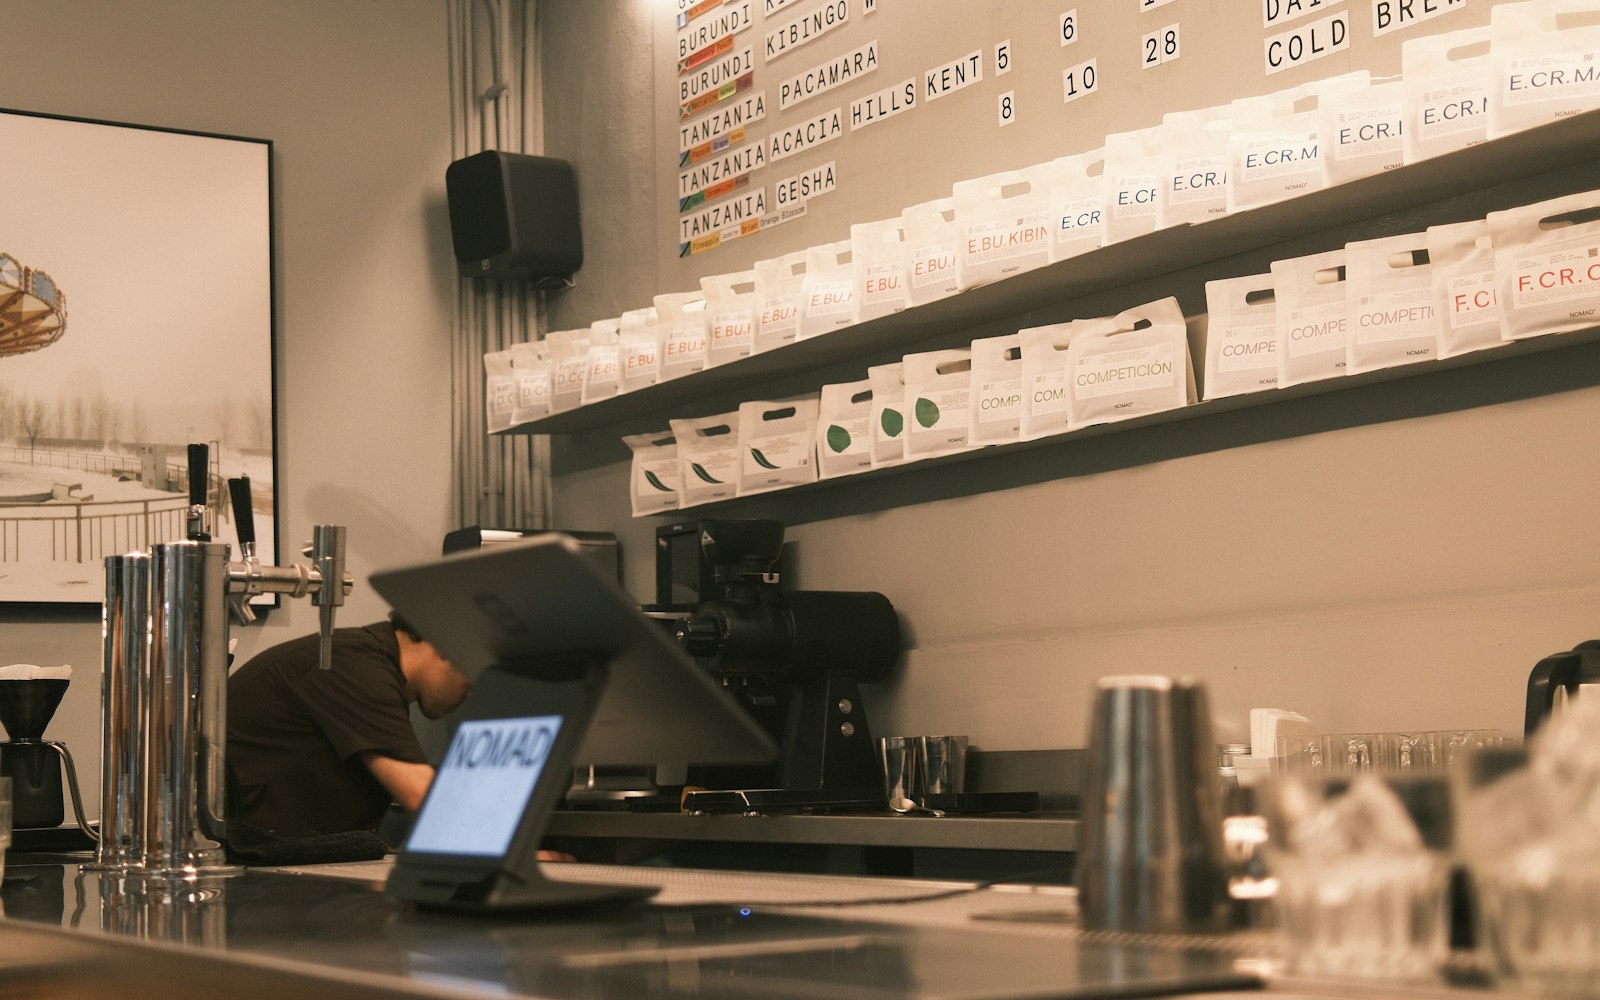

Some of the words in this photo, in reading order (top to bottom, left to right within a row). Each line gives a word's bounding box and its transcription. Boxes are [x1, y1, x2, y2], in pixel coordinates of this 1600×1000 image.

[680, 4, 749, 57] BURUNDI
[1268, 19, 1345, 67] COLD
[1377, 0, 1460, 29] BRE
[682, 50, 750, 100] BURUNDI
[766, 1, 846, 55] KIBINGO
[681, 145, 764, 193] TANZANIA
[772, 114, 840, 157] ACACIA
[853, 83, 914, 125] HILLS
[928, 55, 979, 96] KENT
[998, 46, 1008, 69] 5
[1063, 16, 1074, 40] 6
[682, 96, 764, 147] TANZANIA
[782, 47, 876, 105] PACAMARA
[1424, 97, 1488, 125] E.CR.
[682, 193, 764, 238] TANZANIA
[778, 167, 835, 204] GESHA
[1002, 96, 1012, 119] 8
[1067, 66, 1095, 96] 10
[1146, 30, 1176, 63] 28
[1340, 120, 1402, 145] E.CR.
[1246, 145, 1318, 168] E.CR.M
[1173, 171, 1227, 191] E.CR.
[760, 216, 779, 227] Orange
[782, 206, 805, 220] Blossom
[1061, 210, 1101, 230] E.CR
[915, 255, 956, 276] E.BU.
[866, 276, 901, 294] E.BU.
[1455, 289, 1497, 312] F.C
[1359, 305, 1435, 327] COMPETI
[1569, 309, 1596, 318] NOMAD
[1222, 341, 1277, 357] COMPE
[1077, 360, 1172, 387] COMPETICIÓN
[981, 394, 1022, 410] COMP
[1034, 388, 1066, 403] COM
[452, 726, 551, 769] NOMAD
